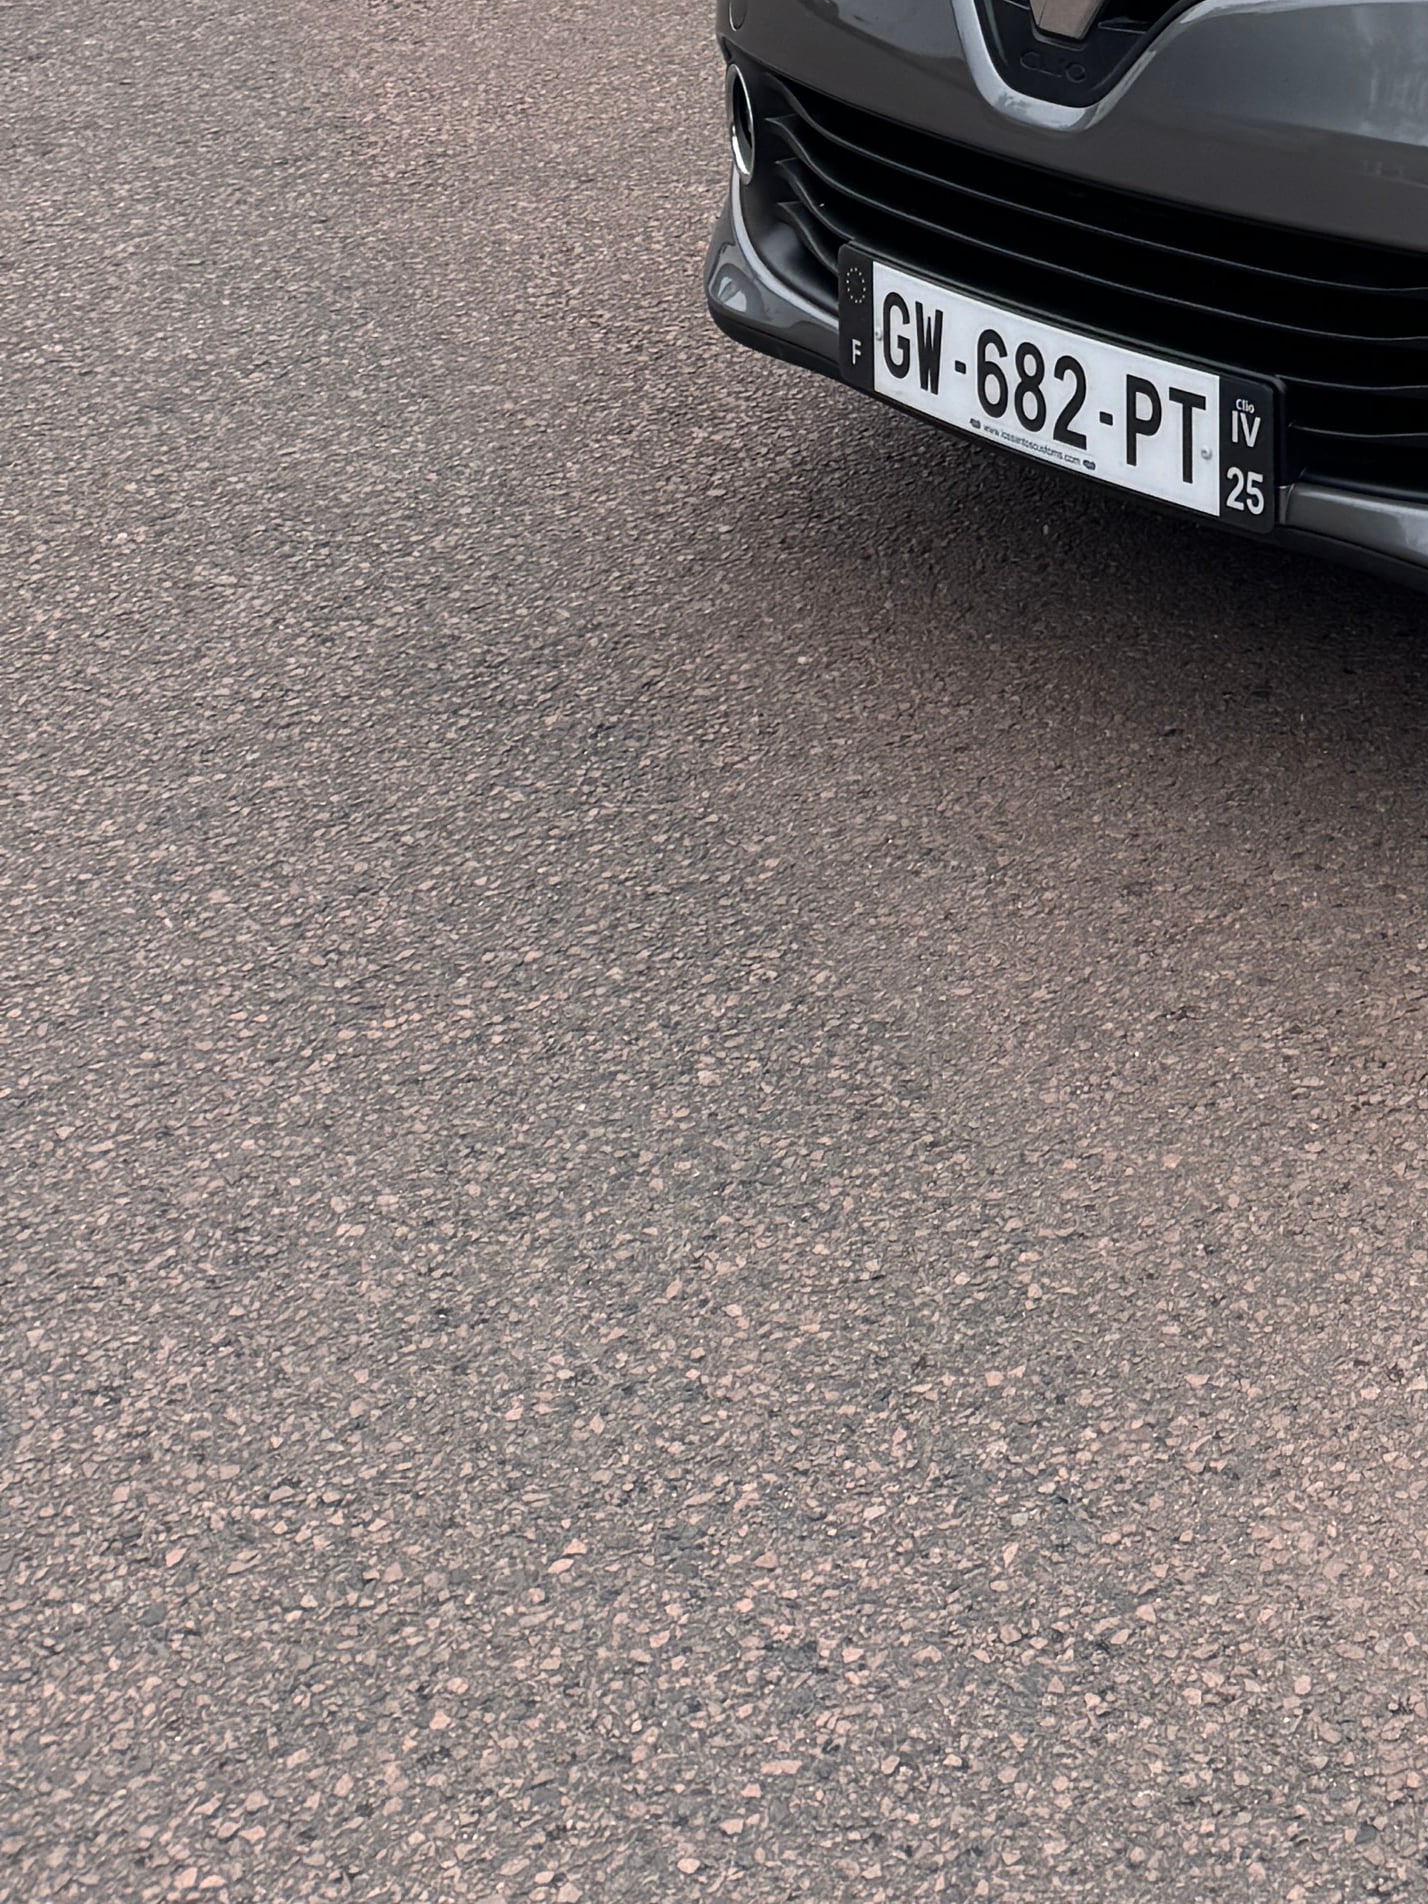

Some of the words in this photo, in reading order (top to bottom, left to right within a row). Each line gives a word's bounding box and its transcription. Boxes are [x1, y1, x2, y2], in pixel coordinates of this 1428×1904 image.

[851, 338, 862, 365] F
[882, 291, 1206, 484] GW-682-PT
[1235, 398, 1255, 414] Clio
[1231, 410, 1261, 448] IV
[1226, 466, 1265, 515] 25
